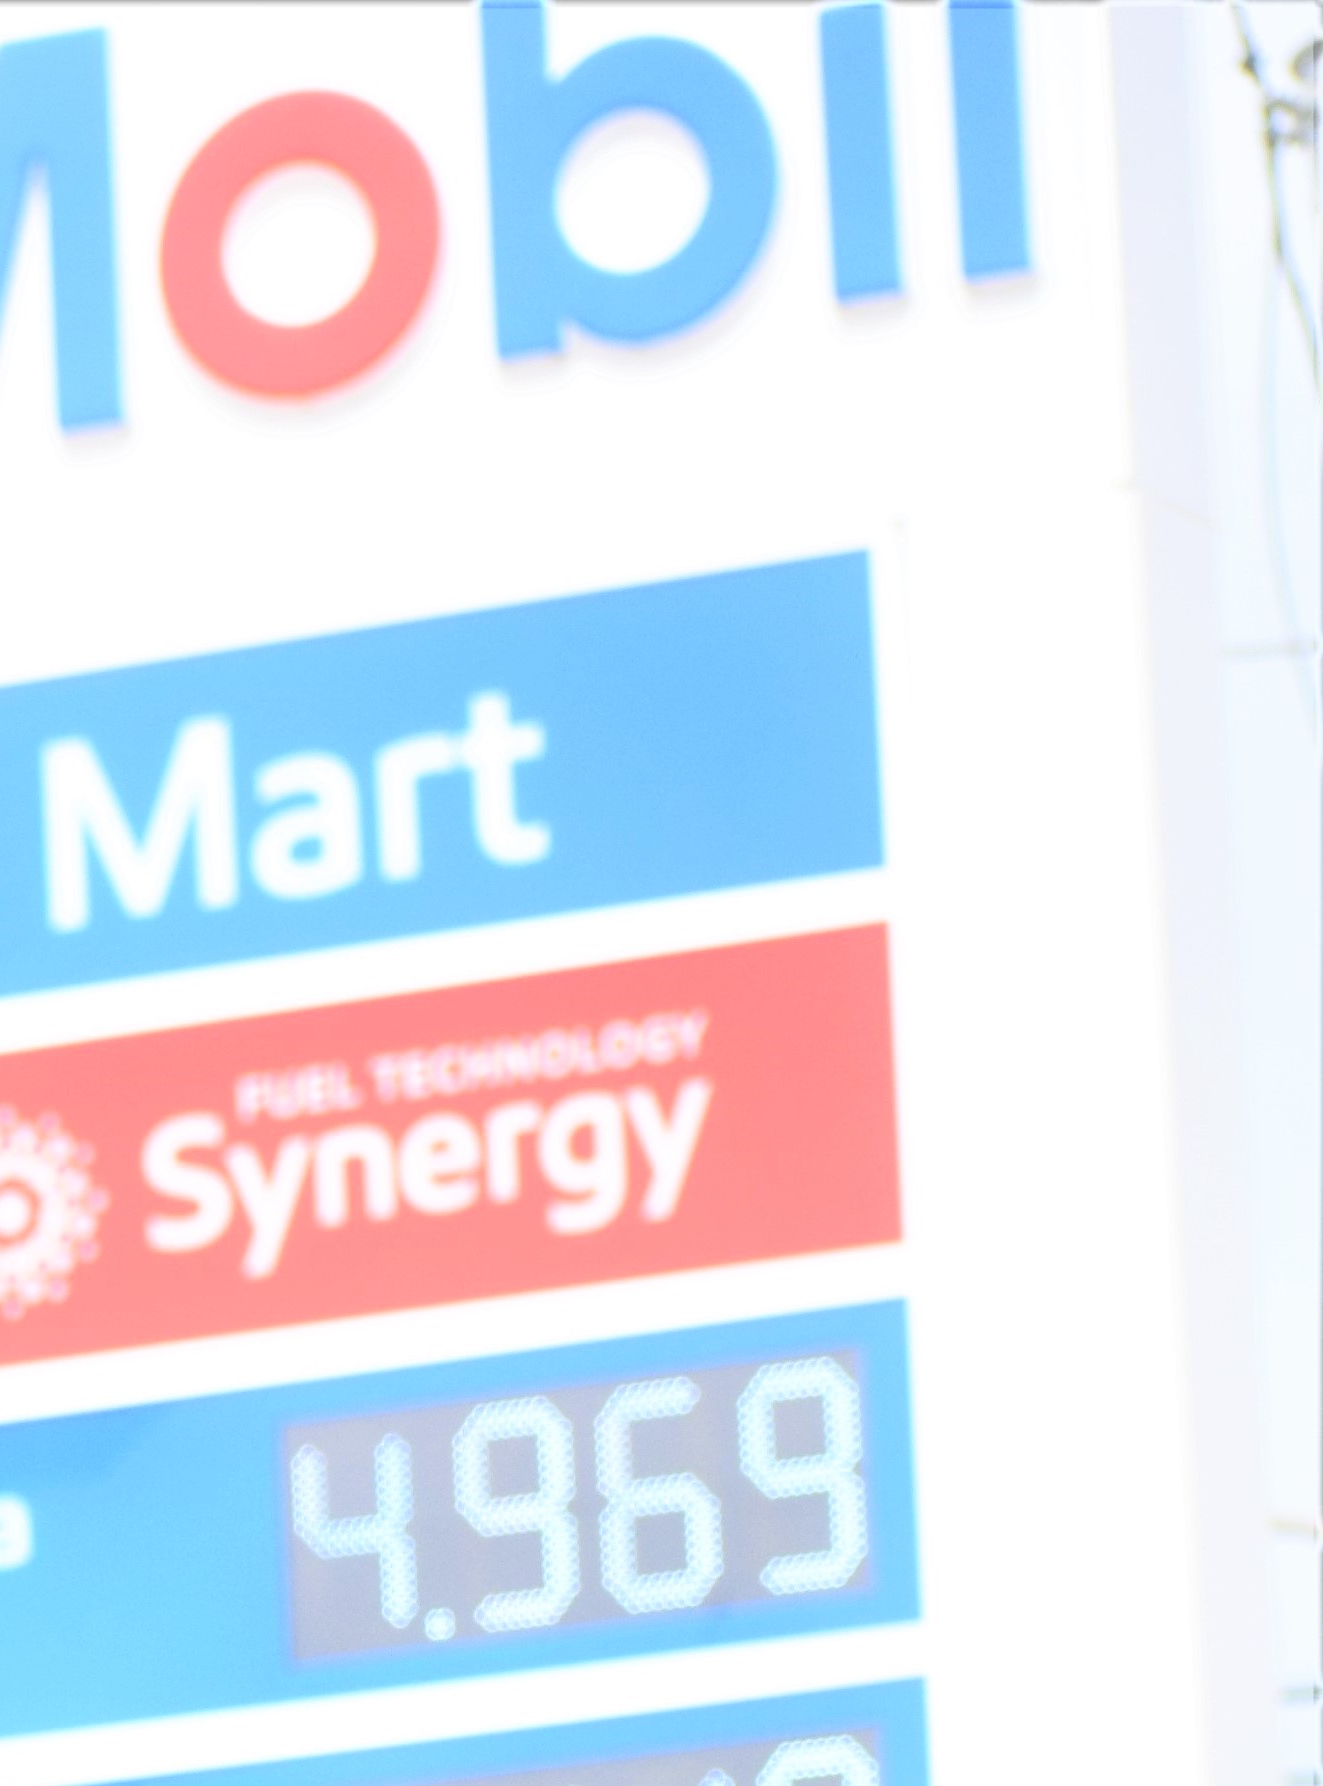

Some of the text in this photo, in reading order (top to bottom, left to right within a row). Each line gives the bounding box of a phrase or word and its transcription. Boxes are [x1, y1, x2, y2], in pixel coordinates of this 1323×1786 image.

[38, 689, 552, 935] Mart
[140, 1076, 714, 1279] Synergy
[233, 1006, 711, 1126] FUEL TECHNOLOGY
[290, 1354, 870, 1642] 4.969
